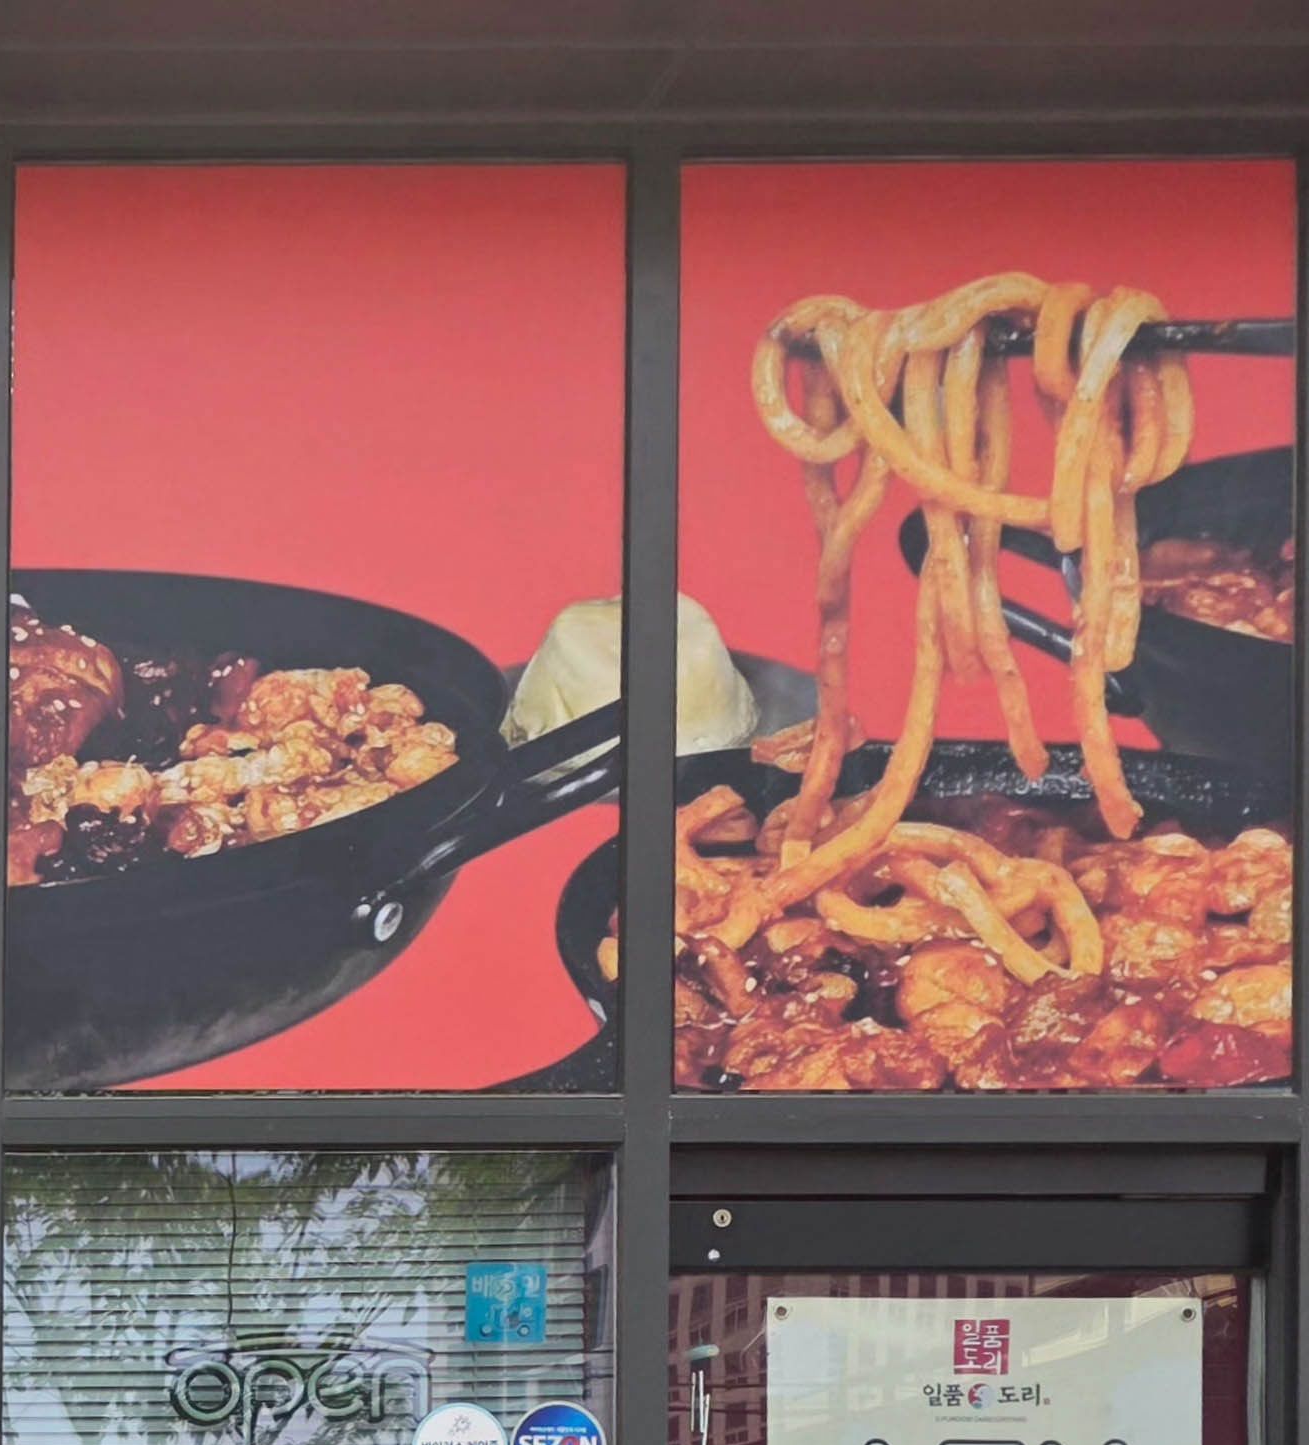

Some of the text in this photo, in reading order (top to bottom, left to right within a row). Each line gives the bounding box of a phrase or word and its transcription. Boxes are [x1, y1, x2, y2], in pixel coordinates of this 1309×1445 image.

[962, 1320, 1010, 1349] 일품
[922, 1383, 1041, 1407] 일품 도리
